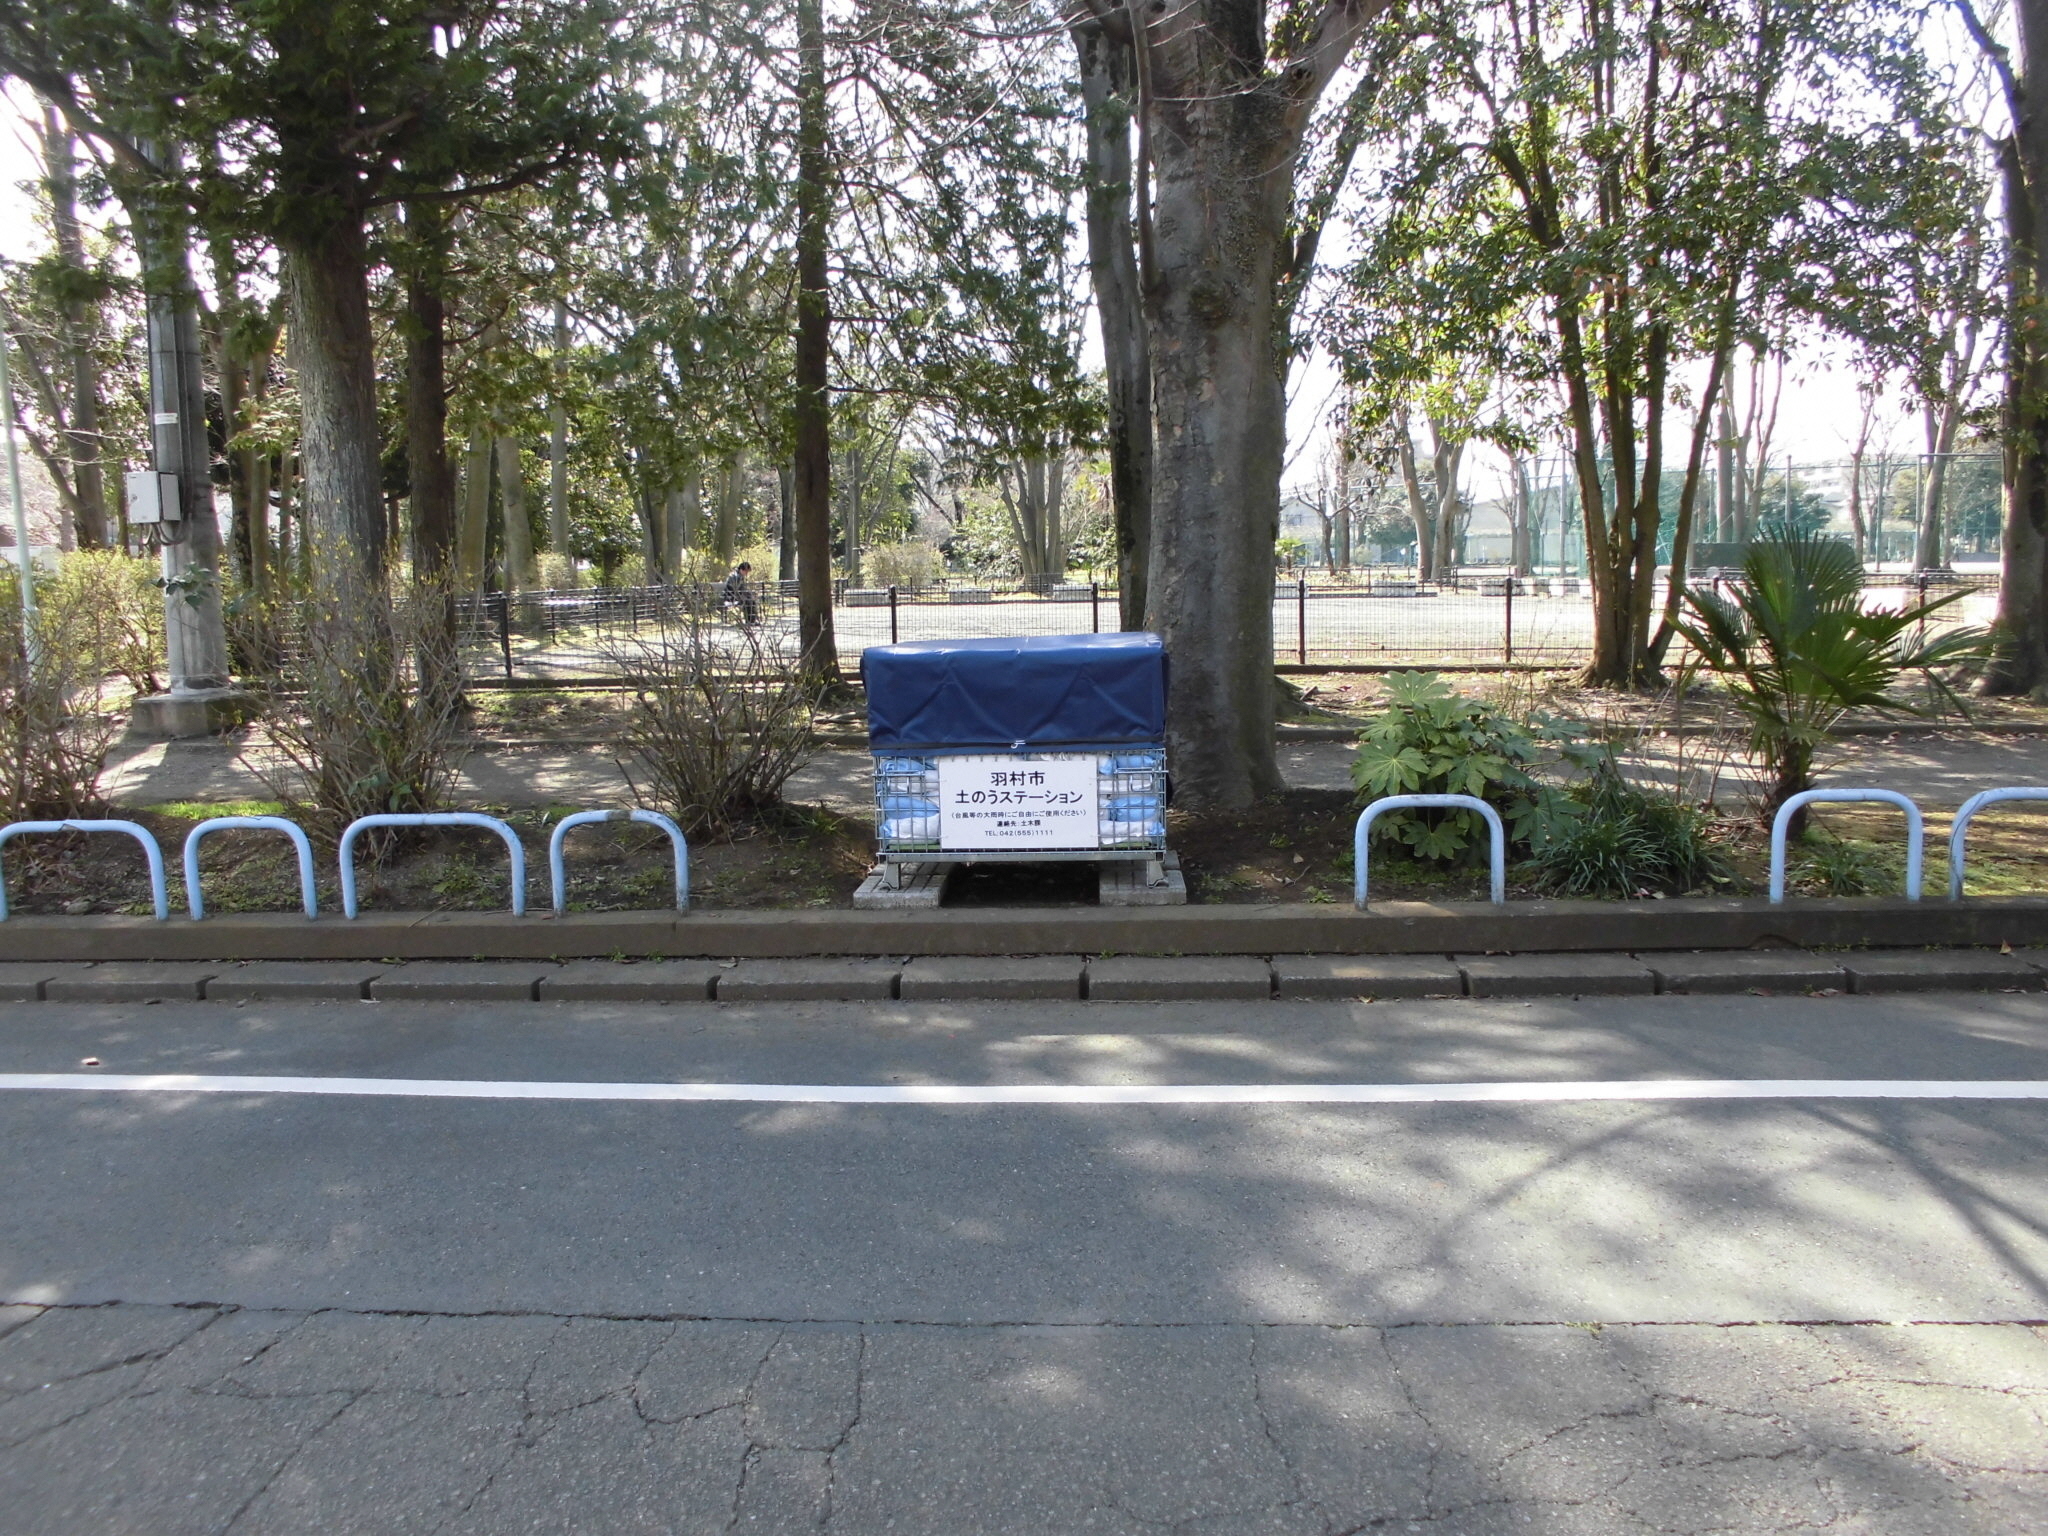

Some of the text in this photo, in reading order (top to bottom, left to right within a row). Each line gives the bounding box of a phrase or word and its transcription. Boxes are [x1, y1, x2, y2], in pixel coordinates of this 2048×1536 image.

[991, 771, 1045, 786] 羽村市
[955, 789, 1083, 804] 土のうステーション
